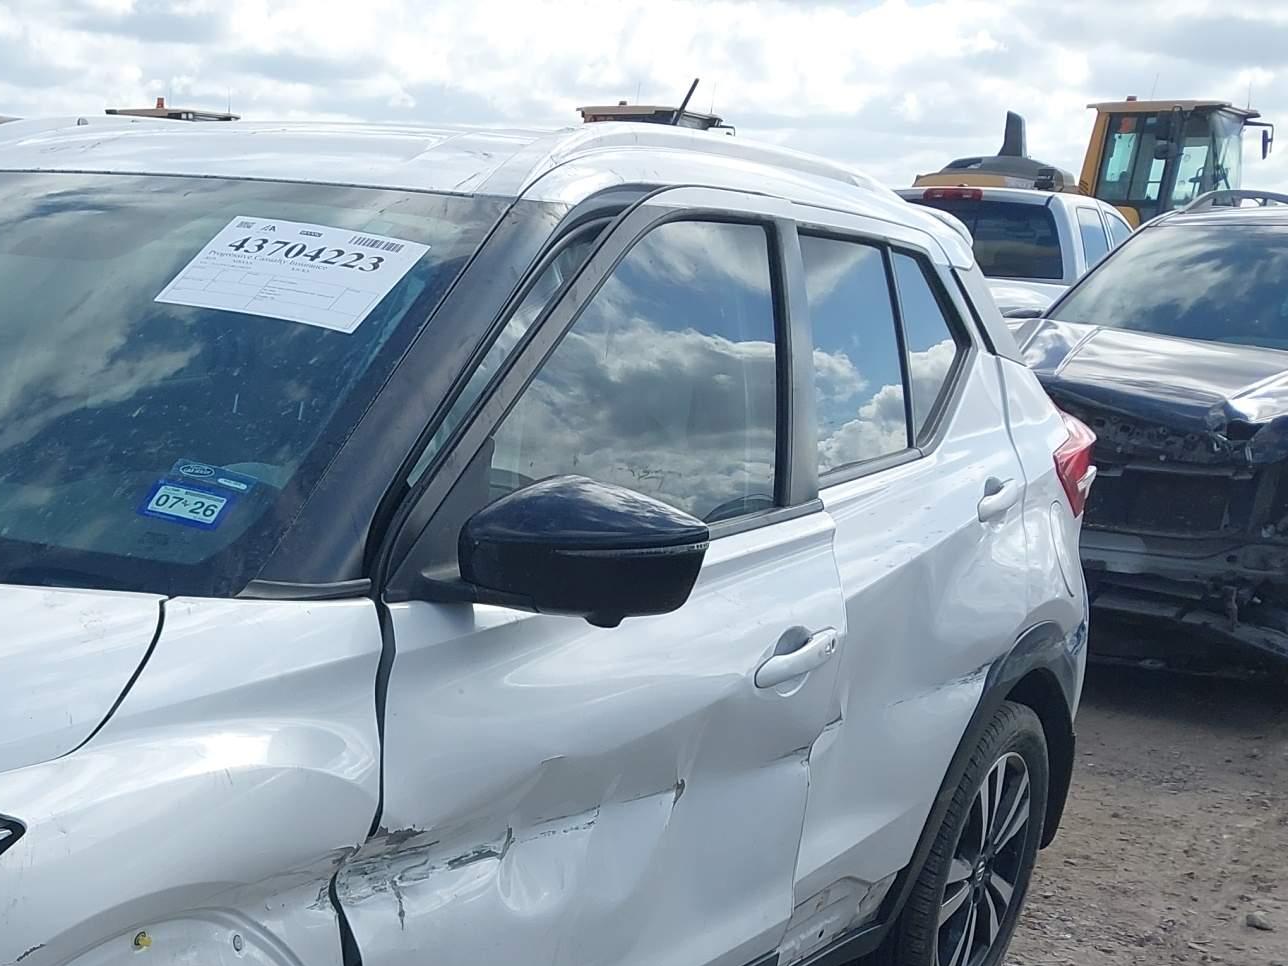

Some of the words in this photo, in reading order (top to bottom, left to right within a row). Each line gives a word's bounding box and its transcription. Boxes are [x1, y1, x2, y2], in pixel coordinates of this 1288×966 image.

[228, 236, 385, 272] 43704223
[155, 494, 184, 509] 07
[189, 501, 218, 518] 26
